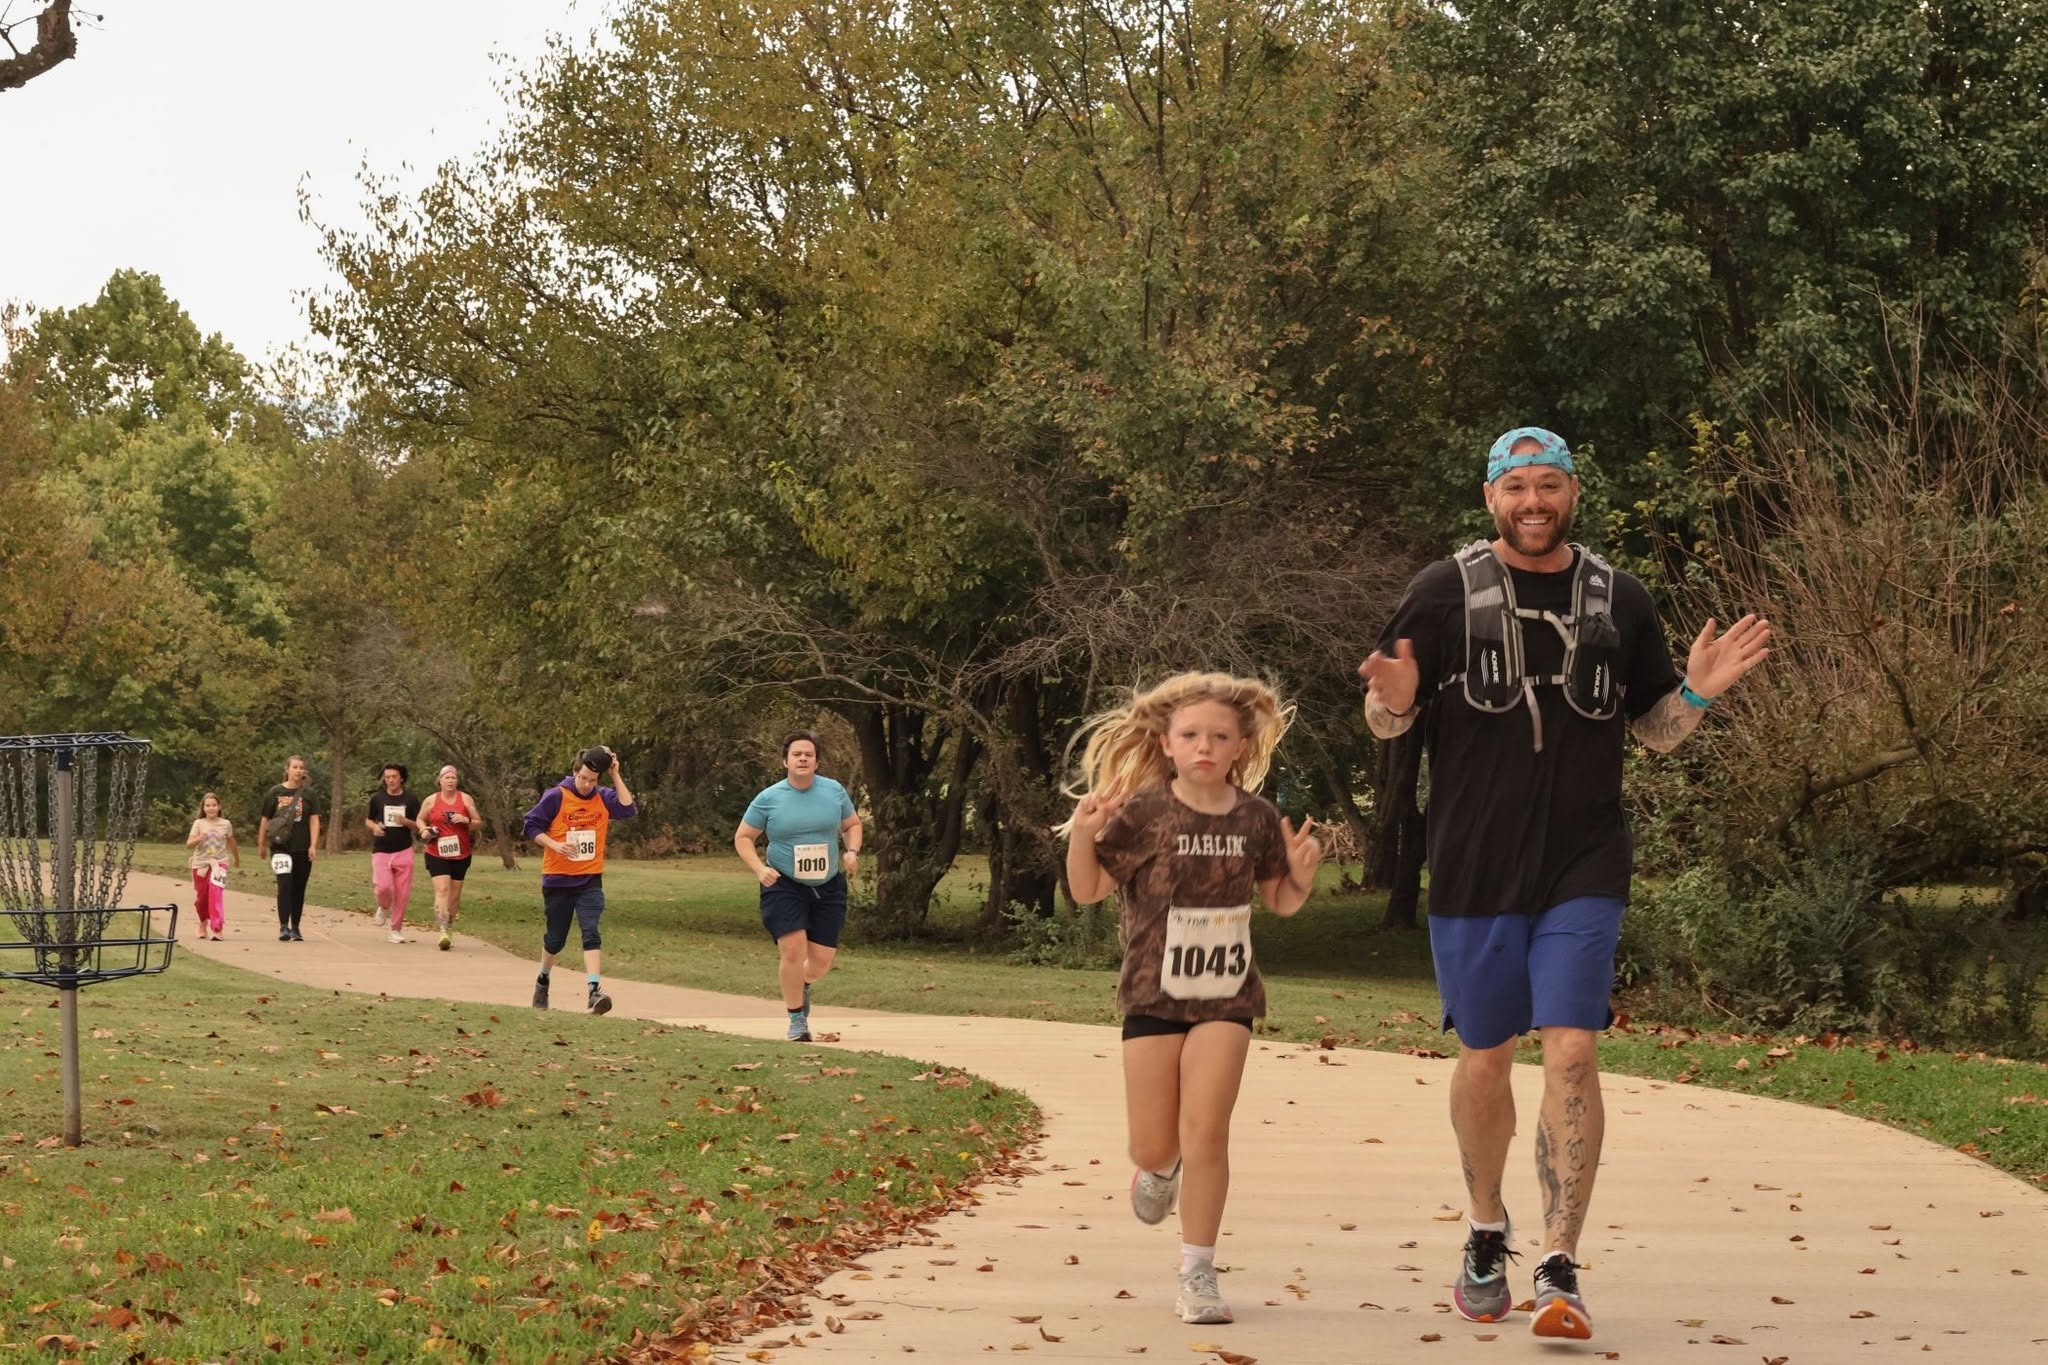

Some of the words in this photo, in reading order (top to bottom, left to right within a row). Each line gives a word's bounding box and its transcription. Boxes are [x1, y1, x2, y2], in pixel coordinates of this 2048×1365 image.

[440, 843, 460, 854] 1008
[576, 841, 595, 855] 36
[274, 860, 290, 870] 234
[797, 857, 826, 872] 1010
[1169, 943, 1247, 979] 1043
